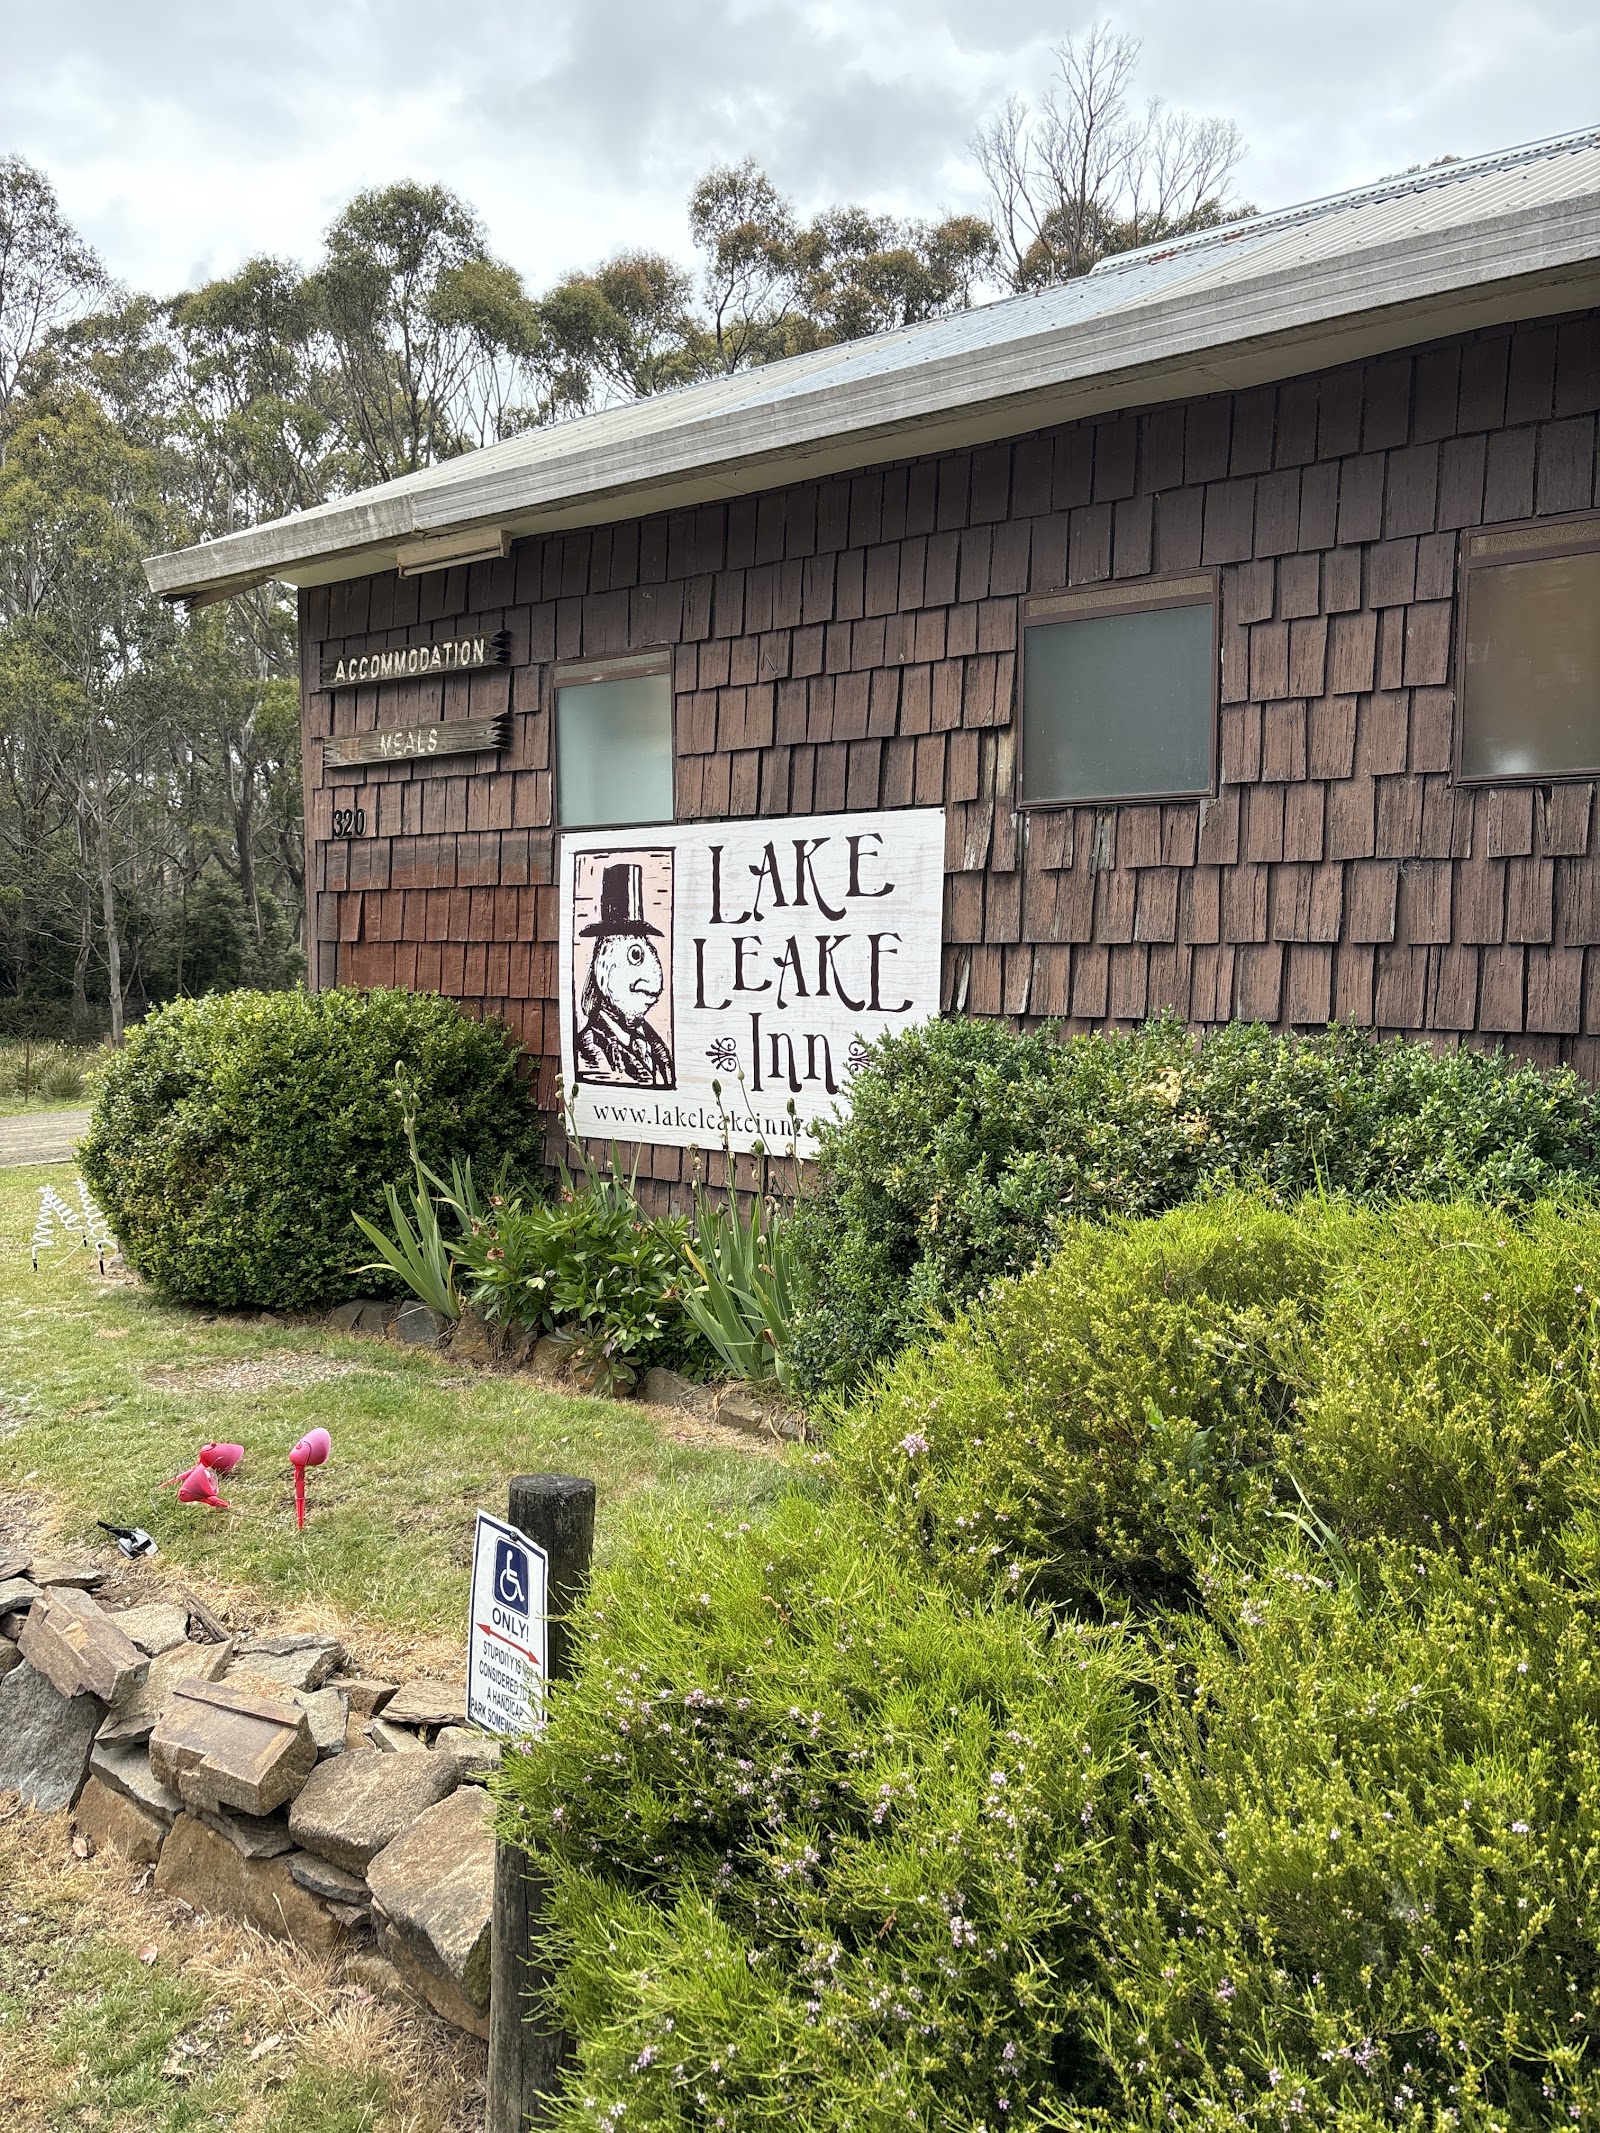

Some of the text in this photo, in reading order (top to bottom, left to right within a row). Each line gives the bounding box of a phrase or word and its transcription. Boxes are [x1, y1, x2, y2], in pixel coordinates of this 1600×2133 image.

[334, 638, 485, 682] ACCOMMODATION
[380, 728, 438, 757] MEALS
[333, 808, 367, 838] 320
[708, 832, 896, 925] LAKE
[693, 932, 914, 1013] LEAKE
[749, 1012, 839, 1095] Inn
[492, 1607, 530, 1643] ONLY!
[482, 1640, 515, 1671] STUPIDITY
[479, 1660, 519, 1695] CONSIDERED
[486, 1686, 492, 1702] A
[470, 1696, 487, 1721] PARK
